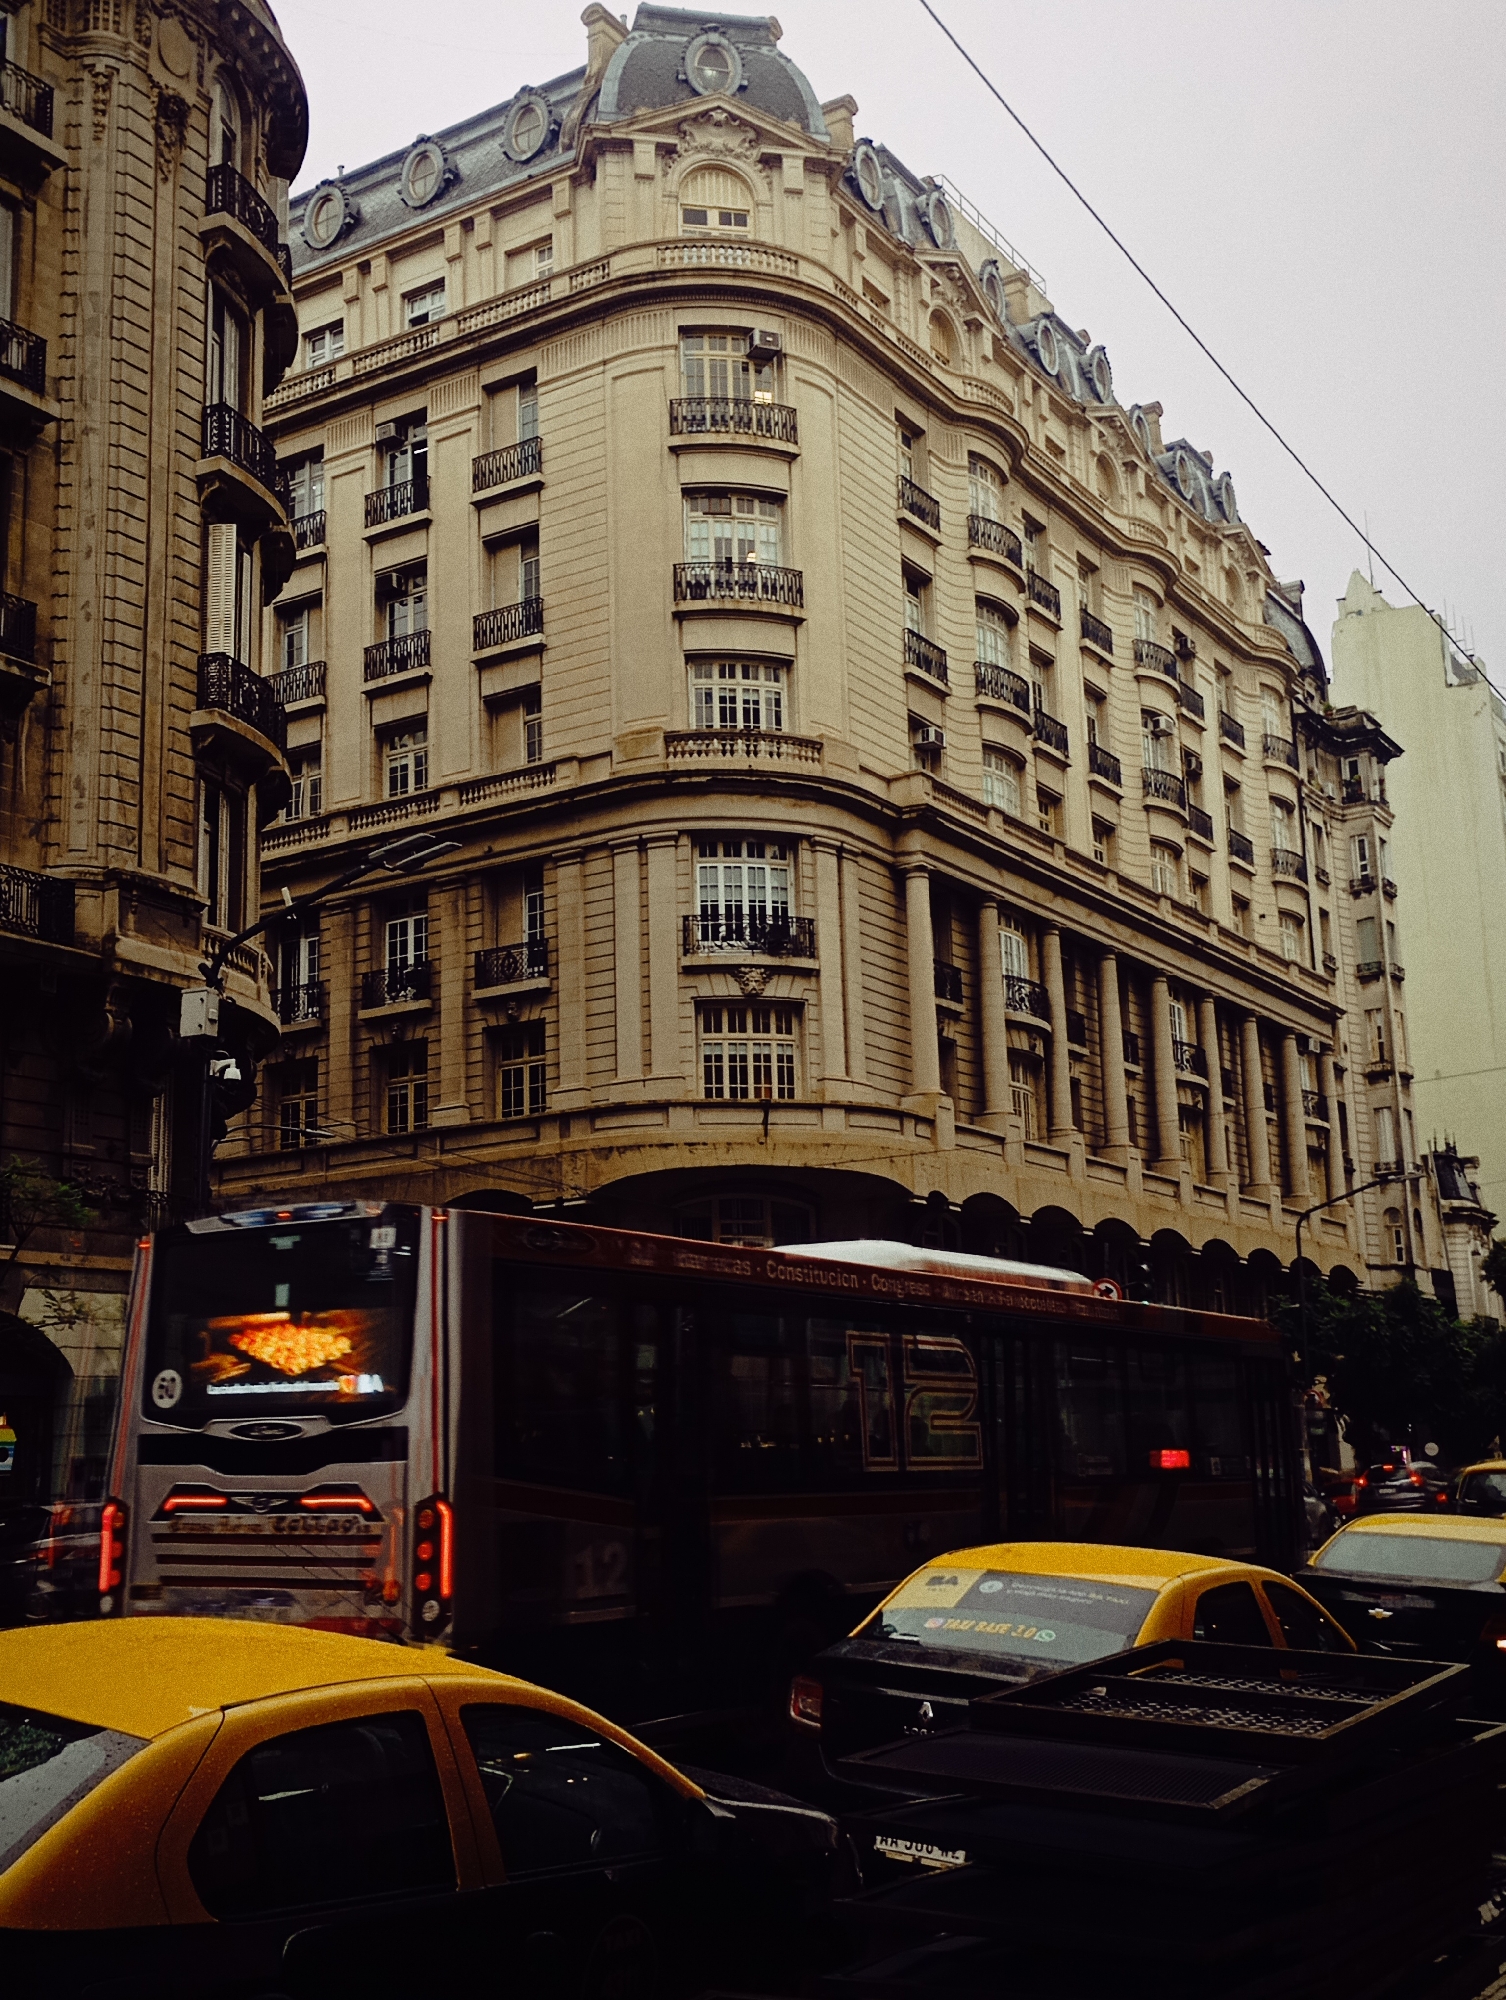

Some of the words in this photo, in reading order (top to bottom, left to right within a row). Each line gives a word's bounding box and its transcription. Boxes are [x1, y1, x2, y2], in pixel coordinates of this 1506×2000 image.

[765, 1258, 859, 1289] Constitucion
[845, 1329, 984, 1472] 12
[576, 1541, 630, 1599] 12
